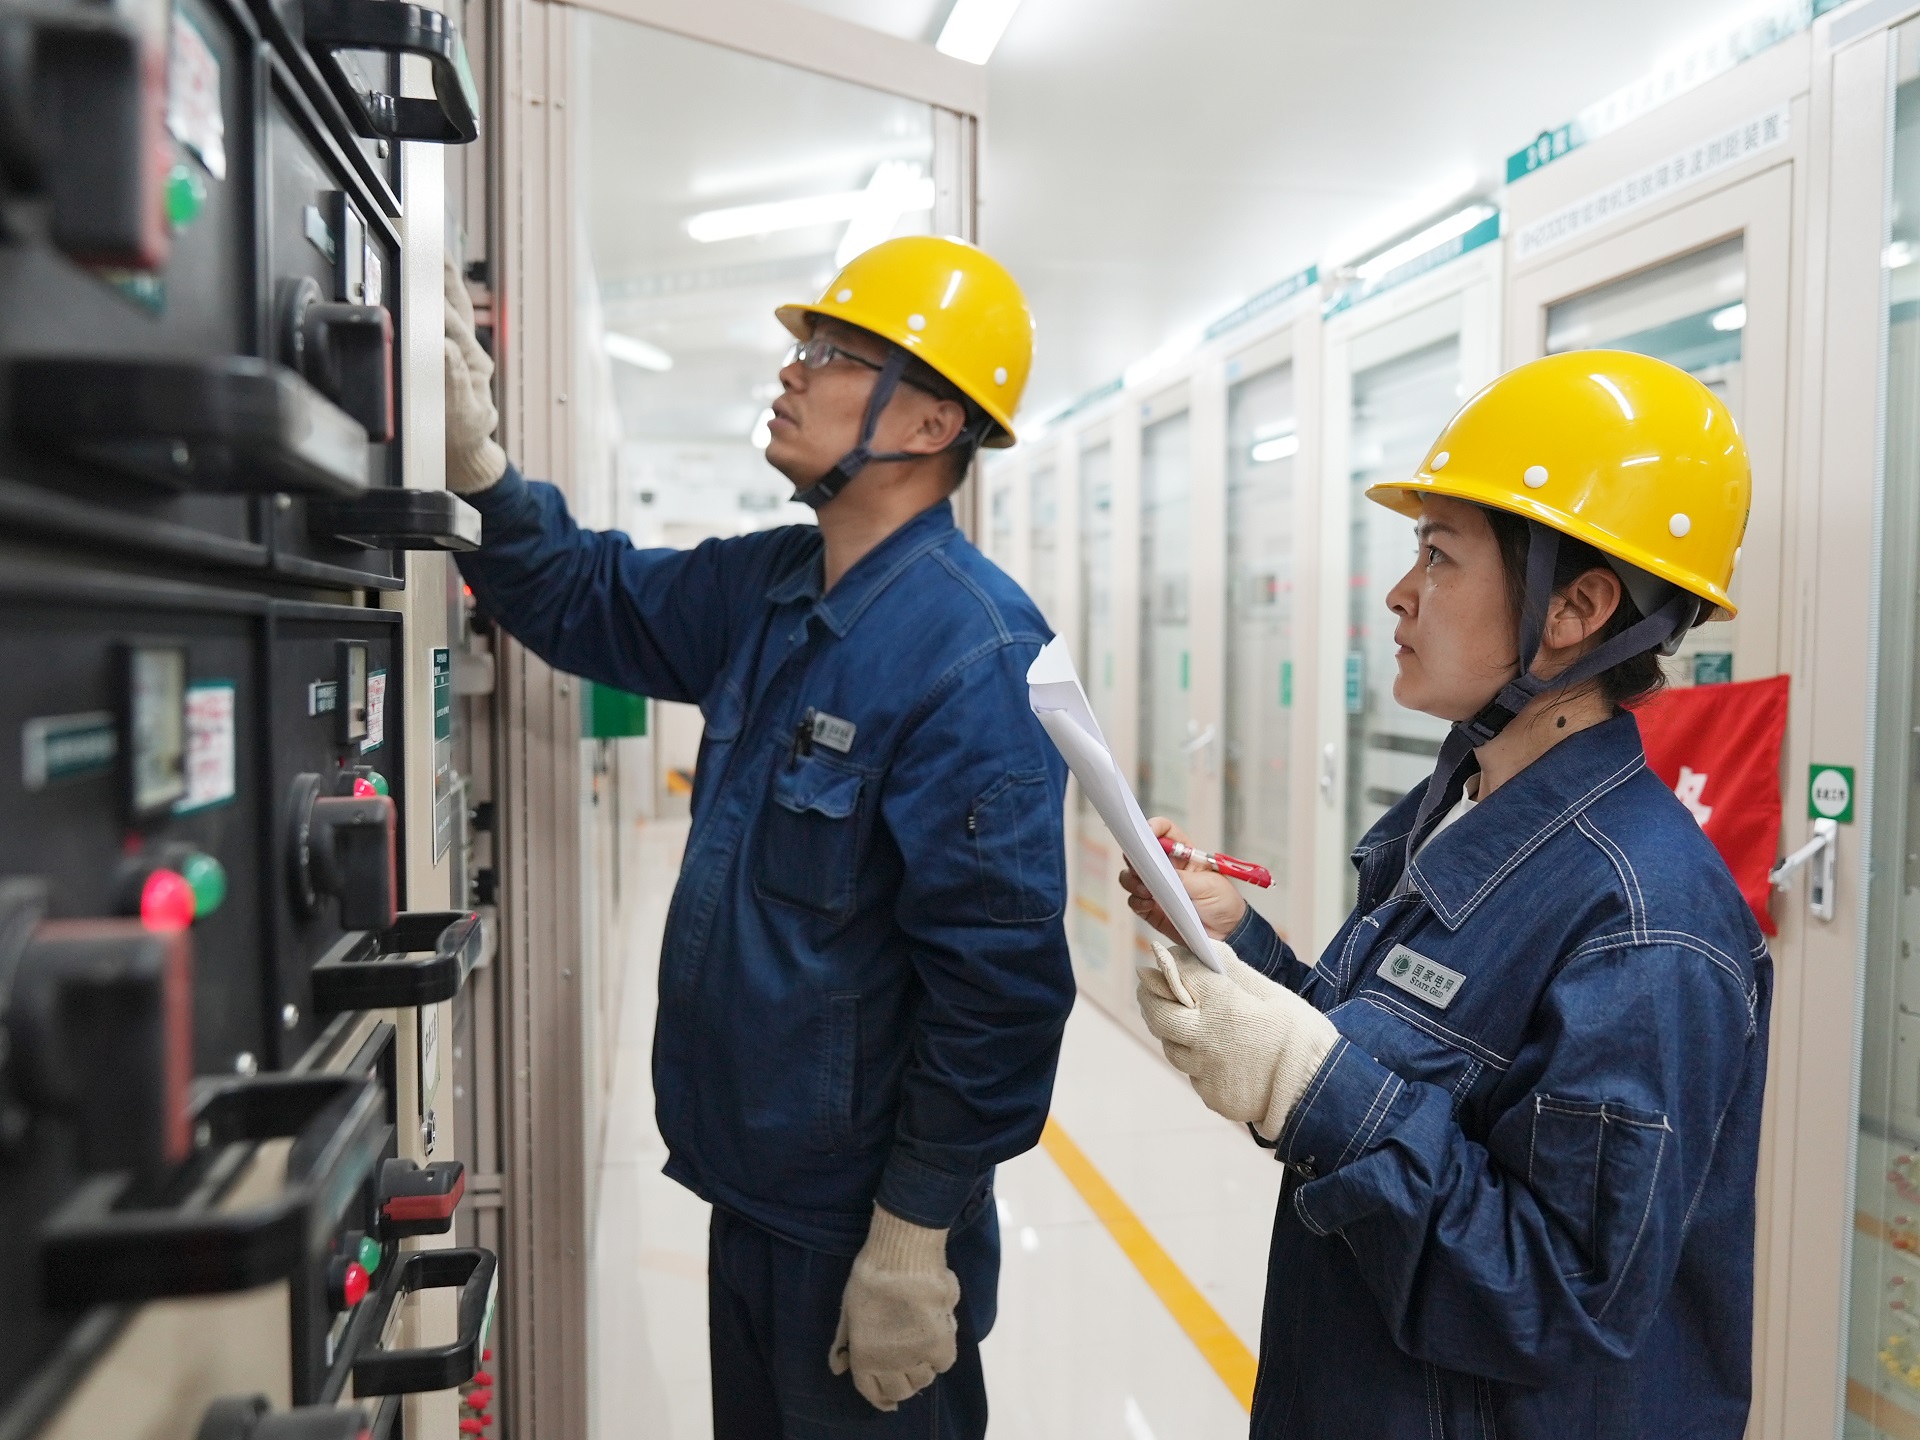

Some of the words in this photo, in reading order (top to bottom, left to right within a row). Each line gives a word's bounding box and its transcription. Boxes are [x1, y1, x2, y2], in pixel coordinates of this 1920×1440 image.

[1410, 977, 1430, 992] STATE
[1429, 986, 1444, 998] GRID
[1412, 963, 1454, 992] 国家电网
